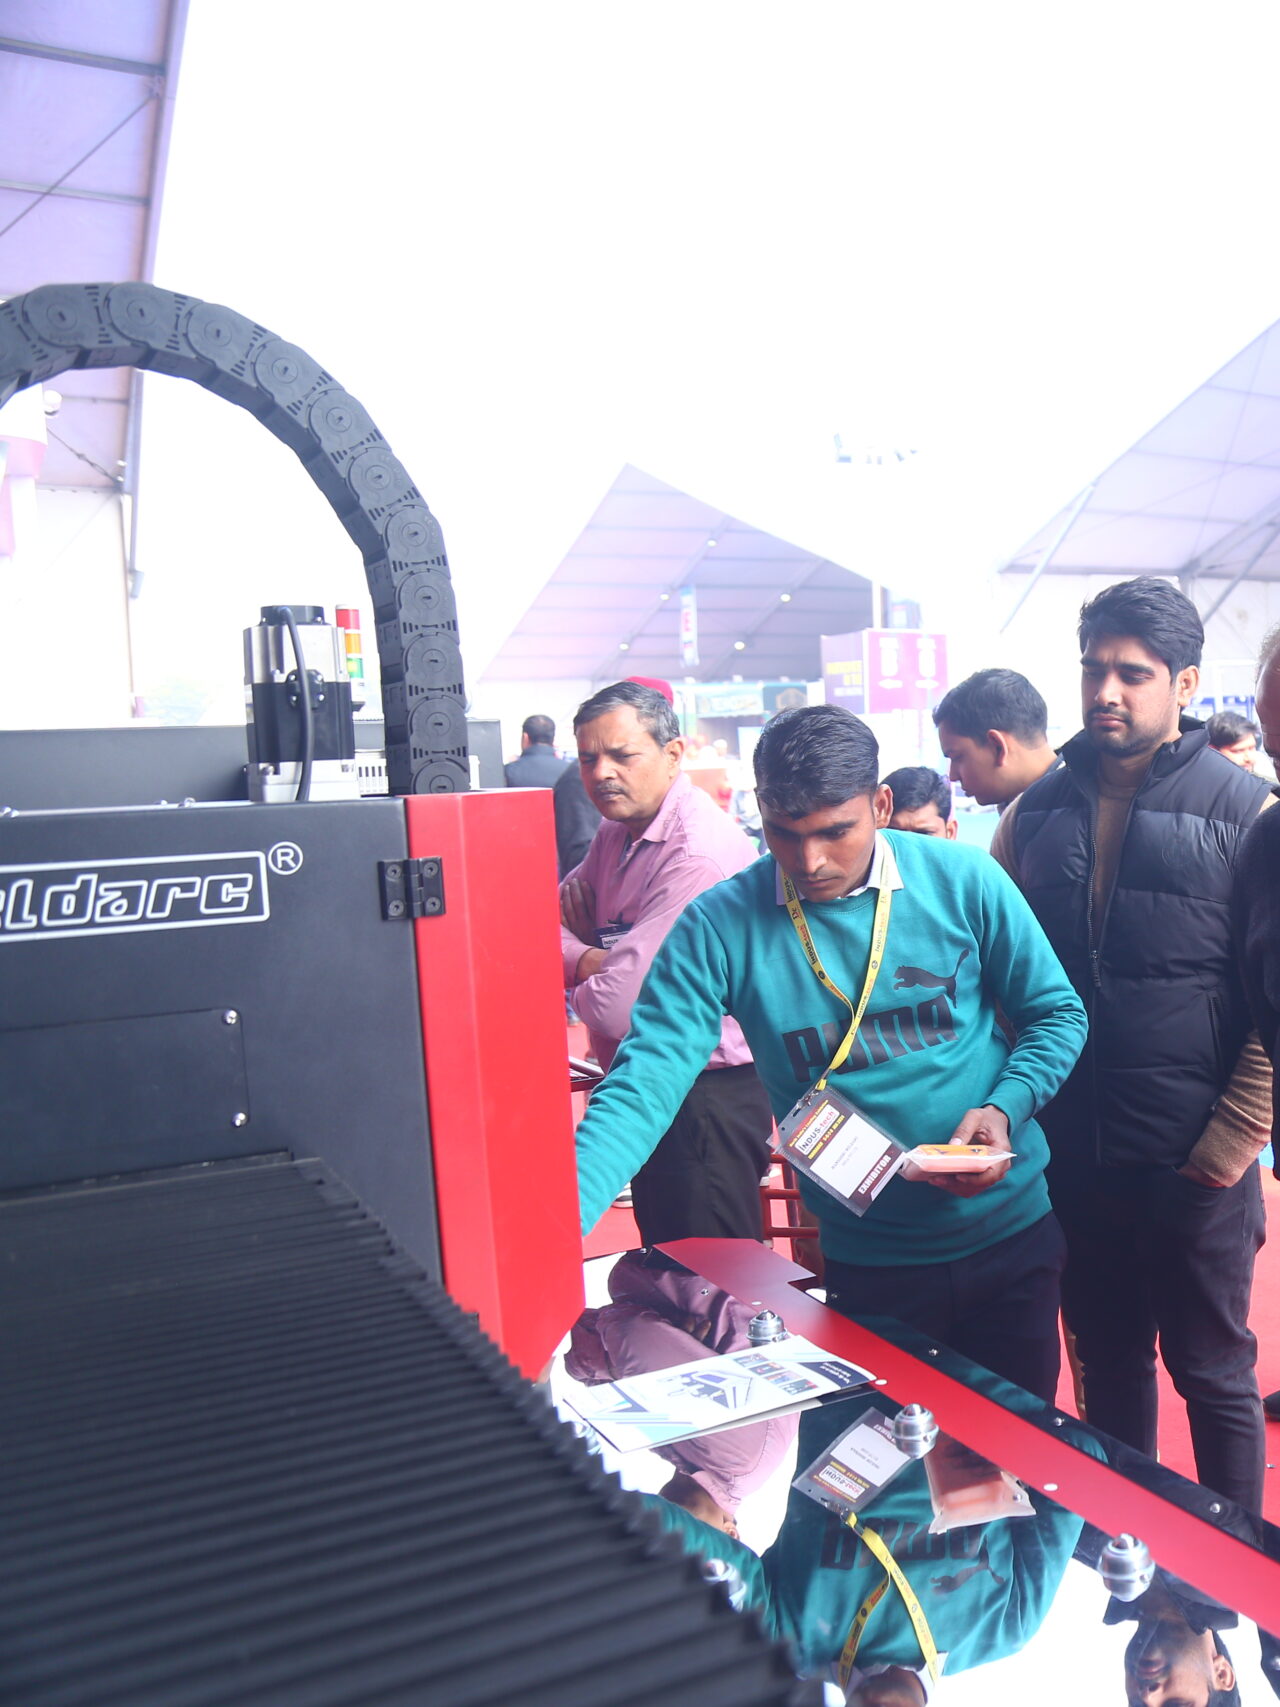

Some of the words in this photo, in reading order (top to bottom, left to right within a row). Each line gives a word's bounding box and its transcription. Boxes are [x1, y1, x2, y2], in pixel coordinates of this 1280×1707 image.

[0, 872, 254, 930] ldarc
[782, 993, 959, 1084] PUMA
[798, 1108, 835, 1153] INDUS-tech
[857, 1153, 892, 1195] EXHIBITOR
